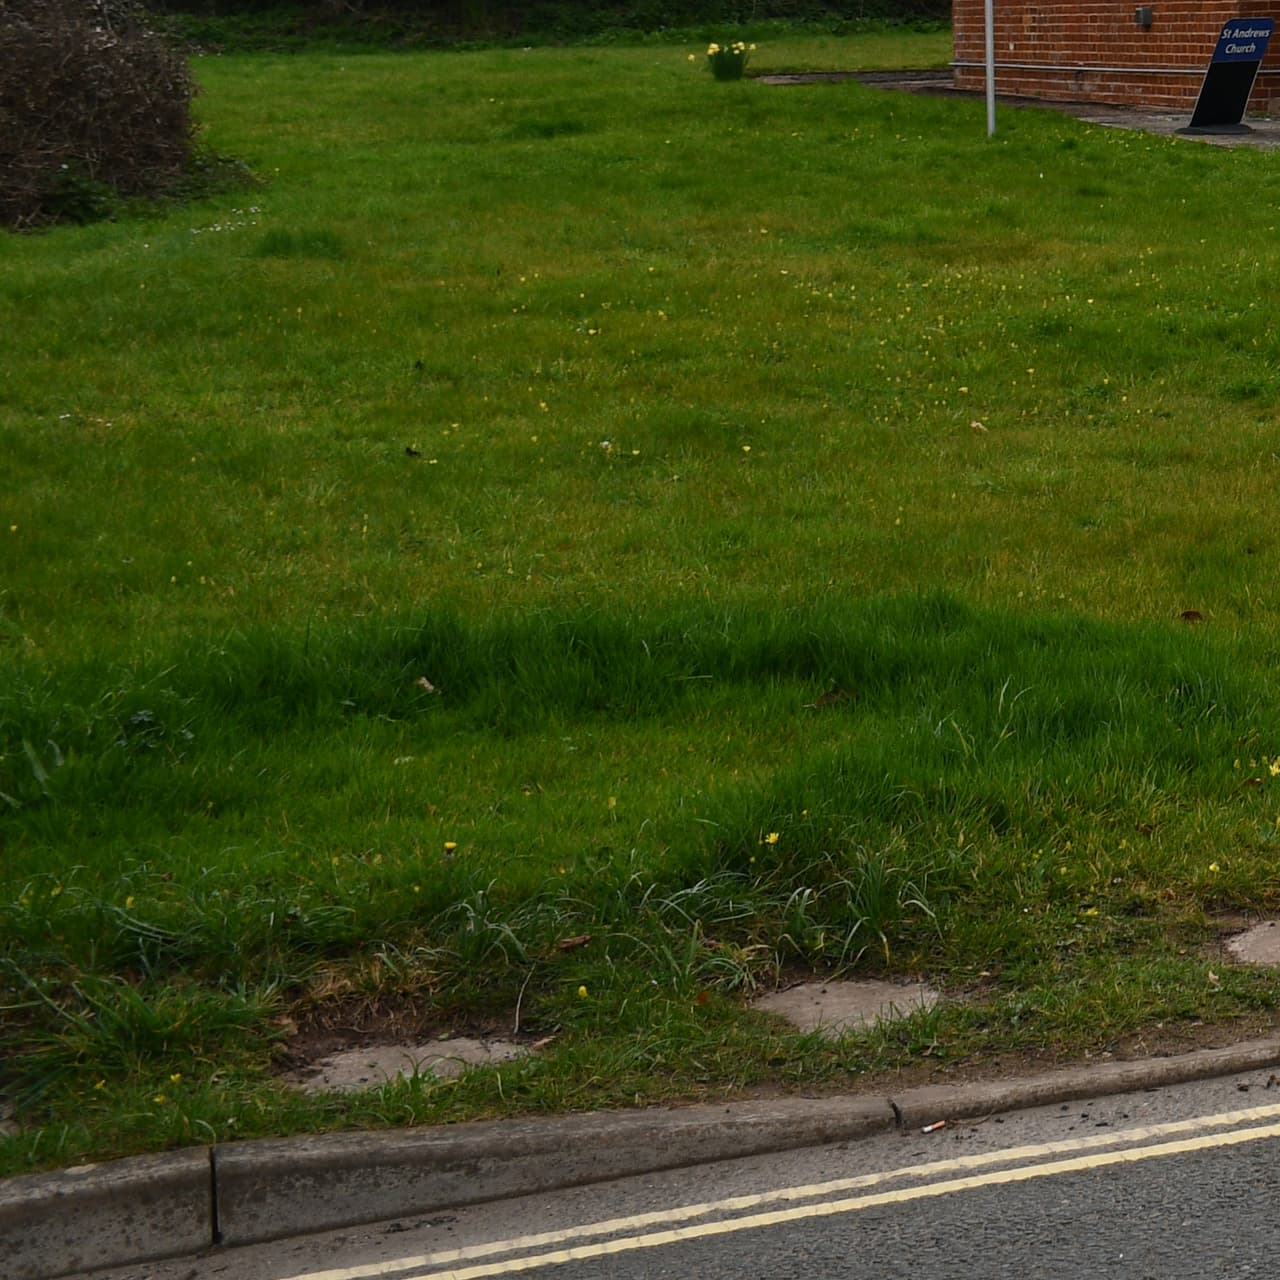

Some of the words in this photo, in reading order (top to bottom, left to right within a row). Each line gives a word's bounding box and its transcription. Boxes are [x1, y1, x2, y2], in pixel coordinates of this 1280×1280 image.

[1222, 29, 1231, 39] St
[1232, 28, 1271, 39] Andrews
[1225, 43, 1256, 54] Church
